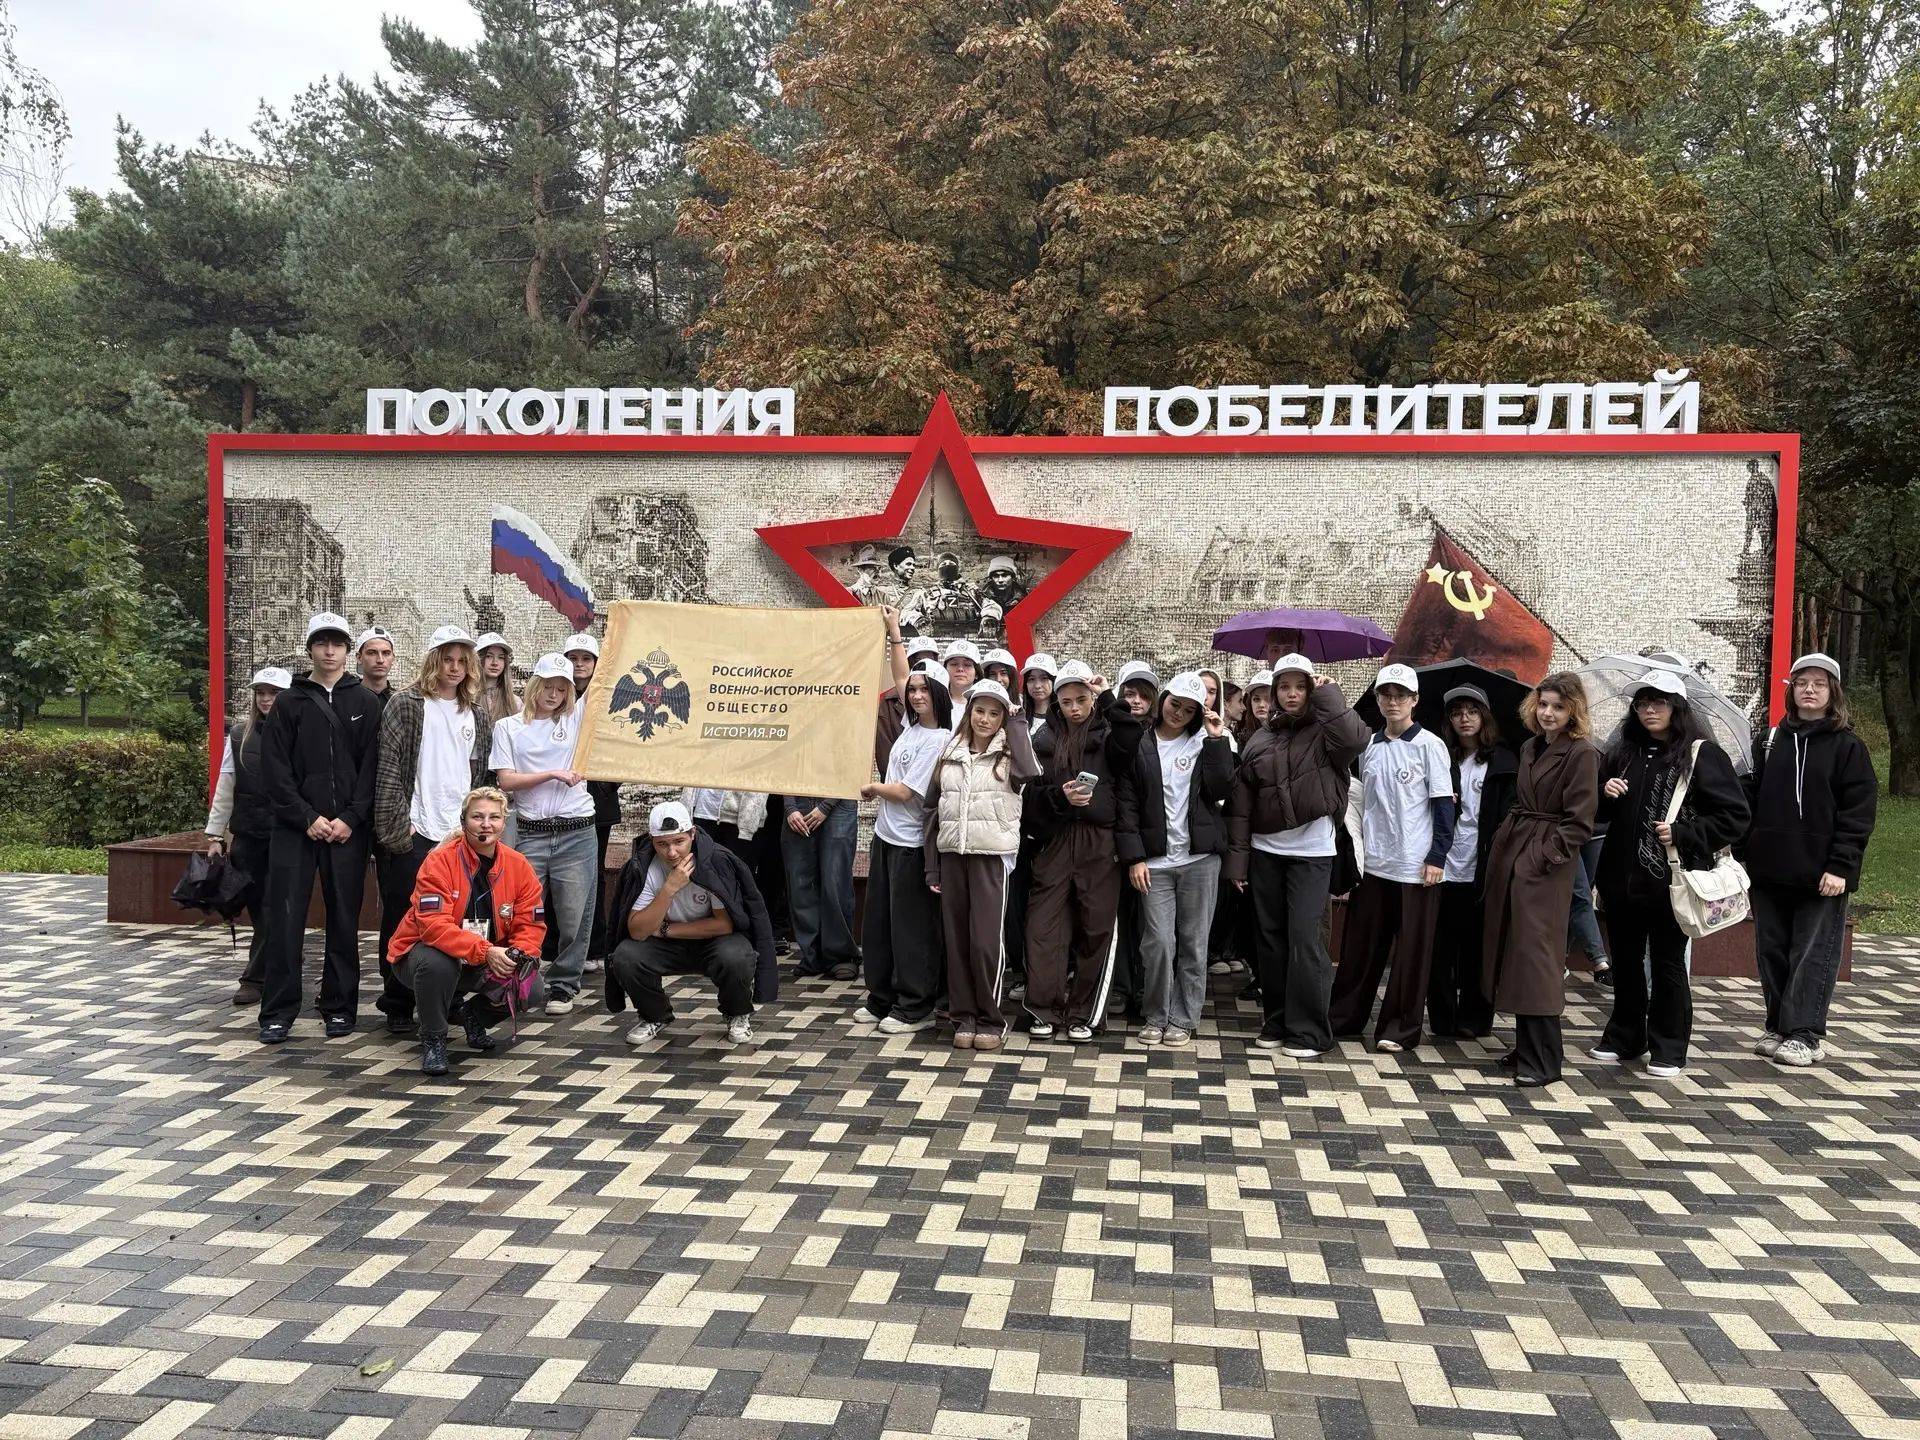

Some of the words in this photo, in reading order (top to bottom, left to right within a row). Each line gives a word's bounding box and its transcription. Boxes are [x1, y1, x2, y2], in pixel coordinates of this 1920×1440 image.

[367, 388, 795, 436] ПОКОЛЕНИЯ
[1103, 368, 1700, 437] ПОБЕДИТЕЛЕЙ
[947, 597, 958, 608] Z
[712, 665, 794, 678] РОССИЙСКОЕ
[709, 683, 860, 696] ВОЕННО-ИСТОРИЧЕСКОЕ
[706, 701, 788, 714] ОБЩЕСТВО
[703, 726, 787, 739] ИСТОРИЯ.РФ
